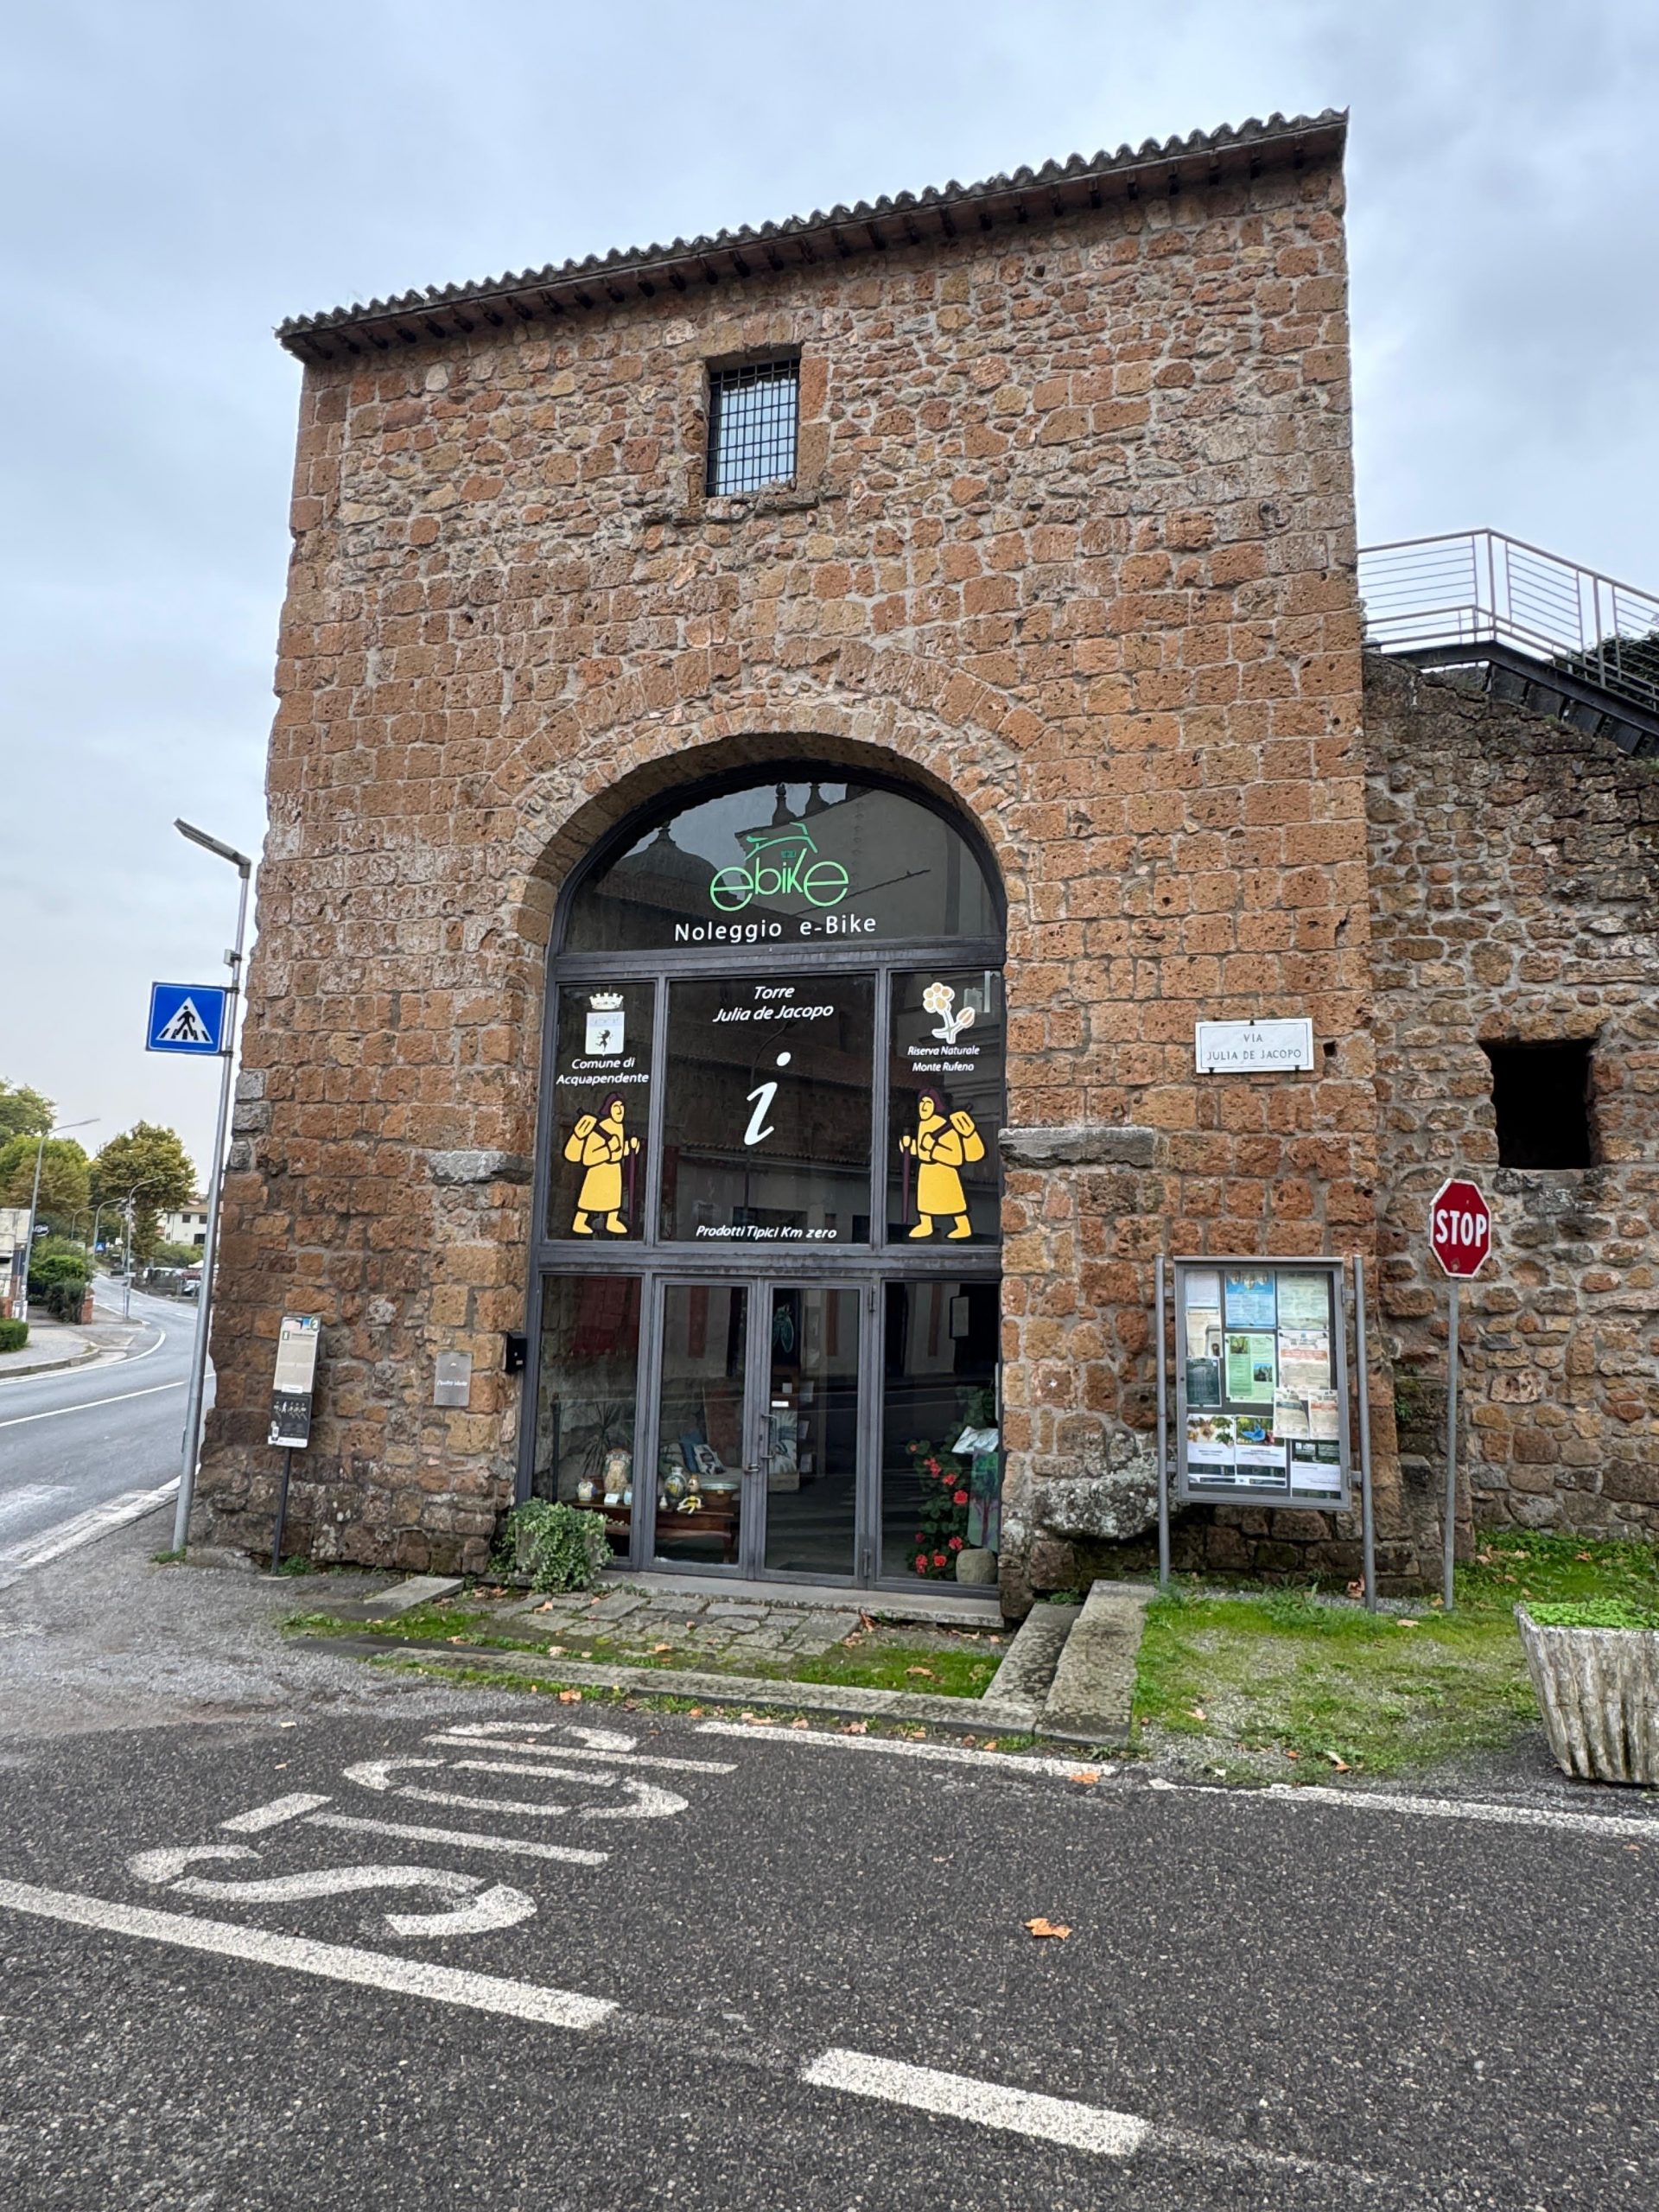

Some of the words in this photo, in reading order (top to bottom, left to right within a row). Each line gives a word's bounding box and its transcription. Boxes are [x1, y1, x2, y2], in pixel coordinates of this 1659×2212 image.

[710, 848, 849, 912] ebike
[674, 919, 782, 943] Noleggio
[800, 913, 877, 935] e-Bike
[754, 985, 795, 1000] Torre
[712, 1007, 751, 1022] Julia
[753, 1006, 773, 1020] de
[774, 1004, 834, 1020] Jacopo
[1243, 1033, 1263, 1043] VIA
[907, 1046, 940, 1056] Riserva
[941, 1045, 981, 1055] Naturale
[1207, 1050, 1238, 1061] JULIA
[1243, 1050, 1255, 1060] DE
[1261, 1048, 1302, 1059] JACOPO
[571, 1058, 620, 1070] Comune
[622, 1057, 635, 1069] di
[912, 1062, 941, 1072] Monte
[942, 1061, 975, 1071] Rufeno
[556, 1072, 649, 1086] Acquapendente
[744, 1052, 791, 1146] i
[696, 1224, 744, 1237] Prodotti
[747, 1225, 778, 1241] Tipici
[780, 1226, 803, 1238] Km
[805, 1229, 837, 1239] zero
[1435, 1209, 1487, 1249] STOP
[125, 1720, 740, 1938] STOP
